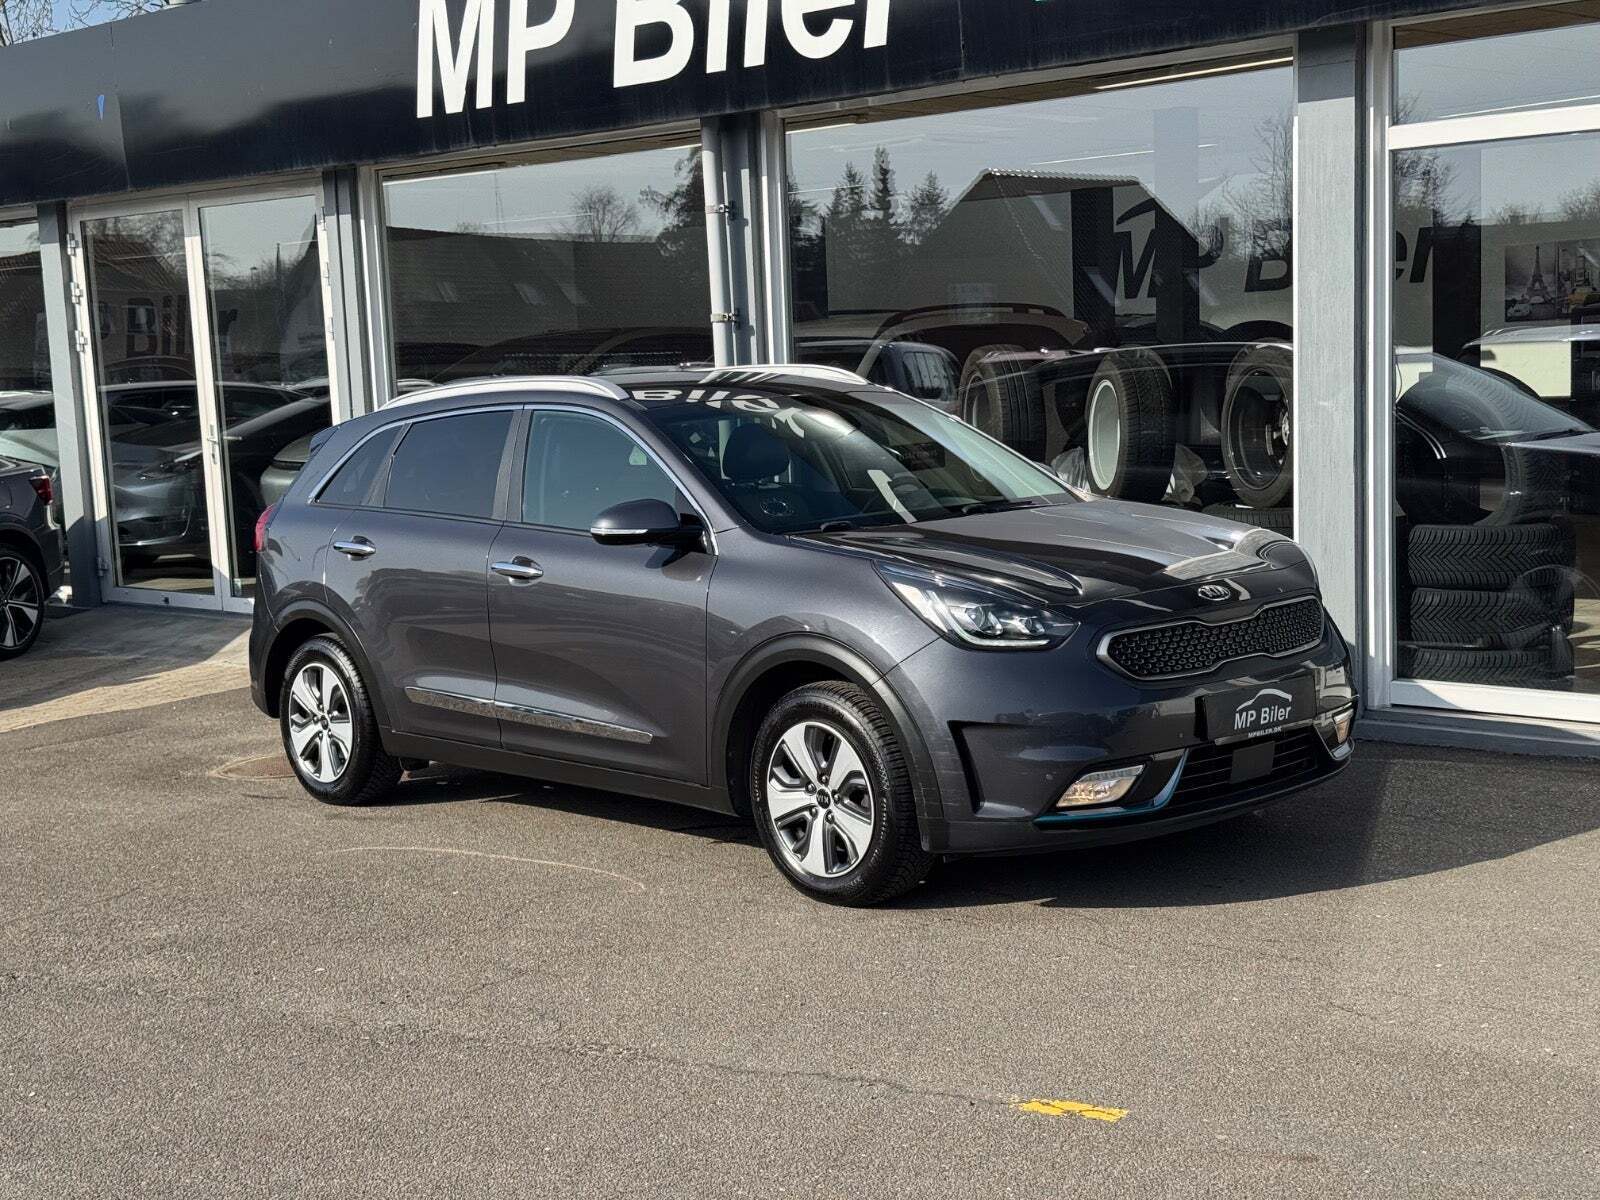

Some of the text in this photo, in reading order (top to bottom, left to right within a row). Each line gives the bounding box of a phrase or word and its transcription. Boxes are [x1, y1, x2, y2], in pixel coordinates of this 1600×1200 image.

[416, 0, 576, 119] MP
[1234, 705, 1292, 730] MP Biler
